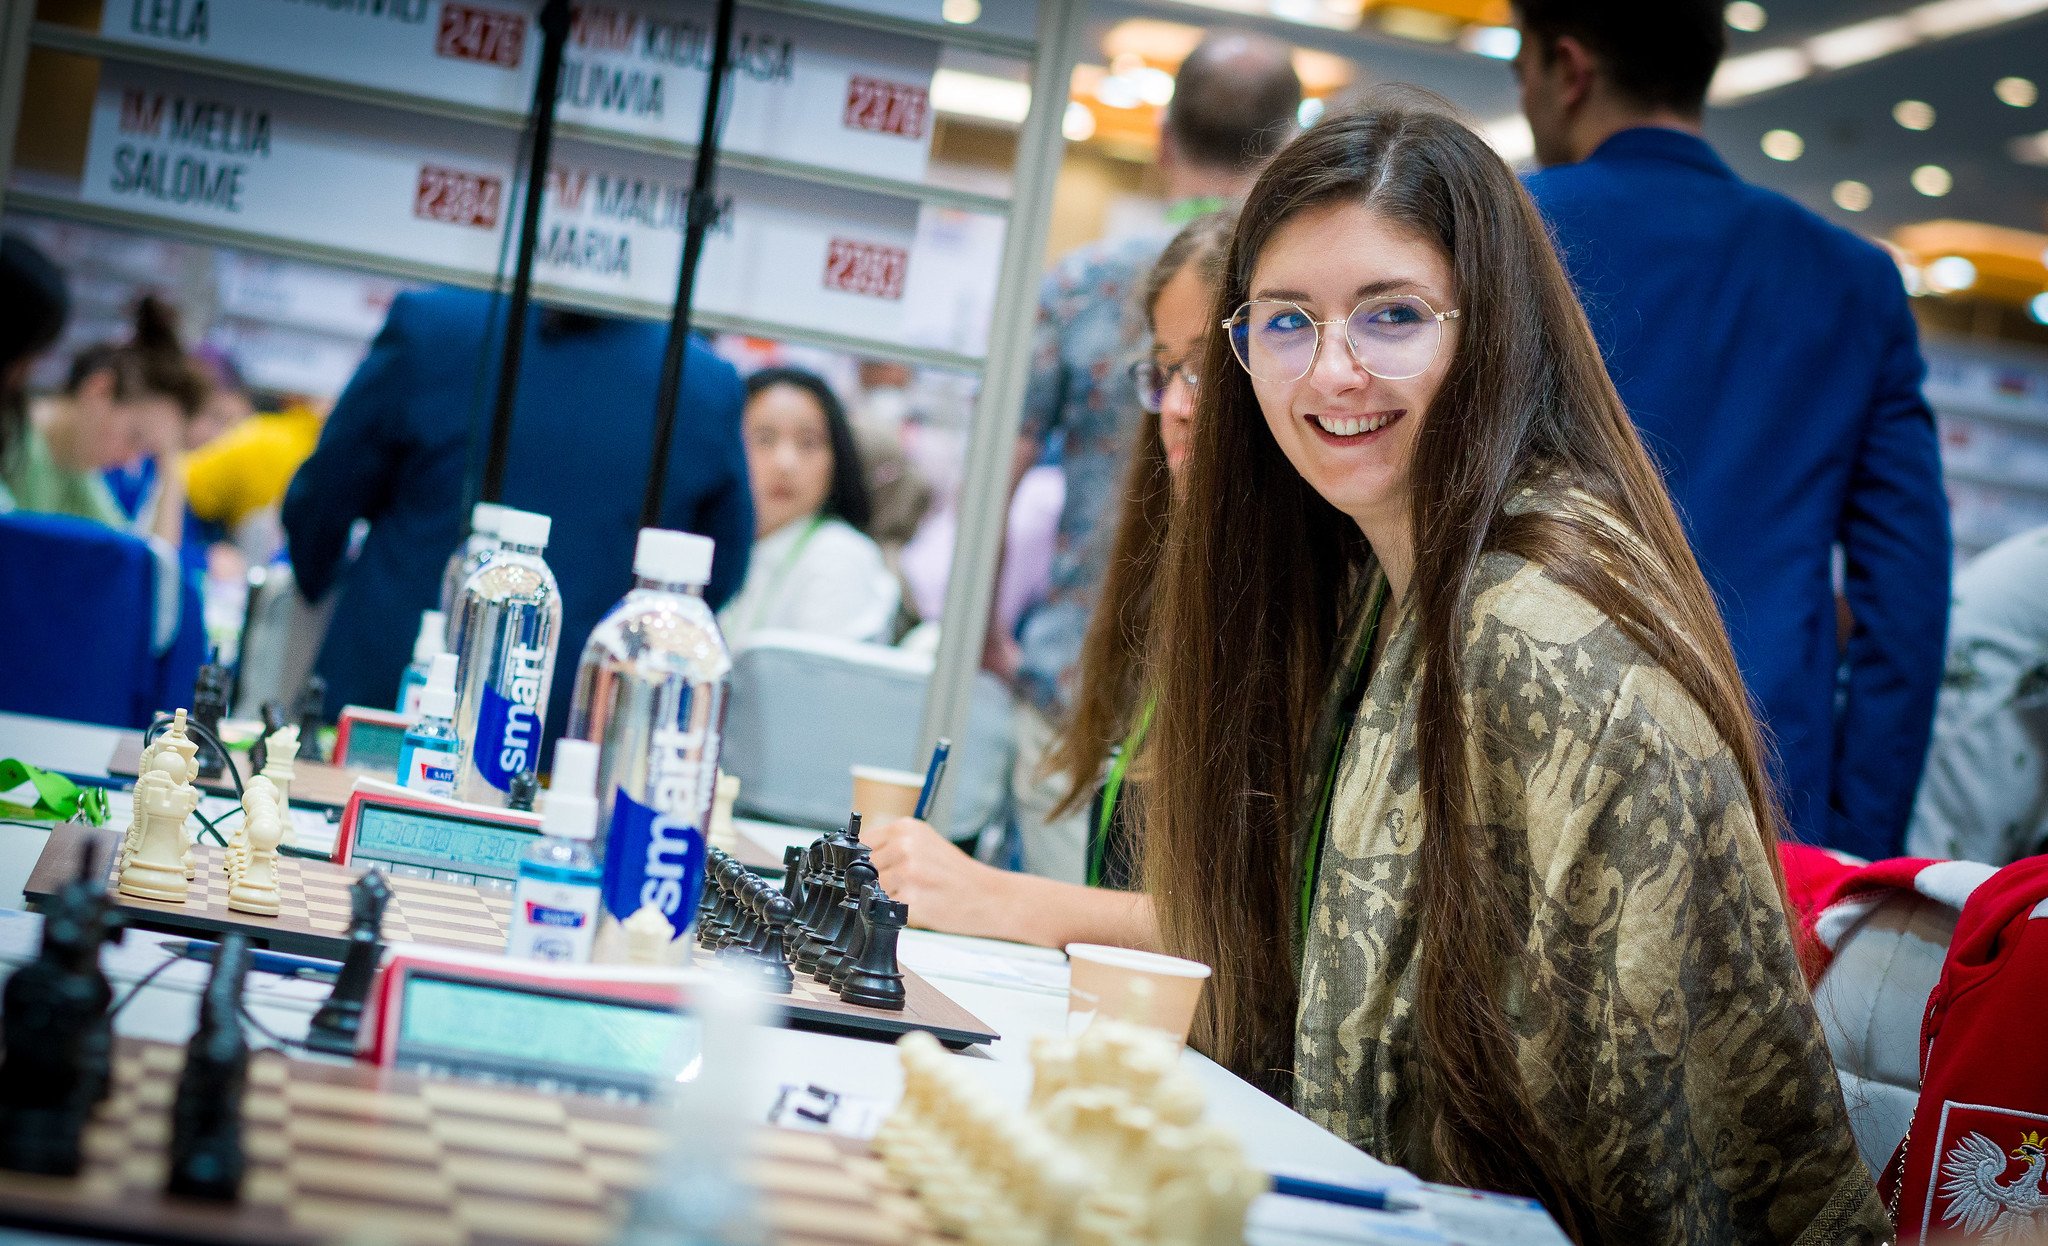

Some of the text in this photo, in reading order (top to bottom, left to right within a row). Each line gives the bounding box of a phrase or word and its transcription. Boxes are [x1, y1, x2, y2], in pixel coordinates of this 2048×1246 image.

[110, 142, 245, 213] SALOME
[171, 97, 272, 159] MELIA
[500, 642, 545, 774] smart
[640, 723, 704, 917] smart
